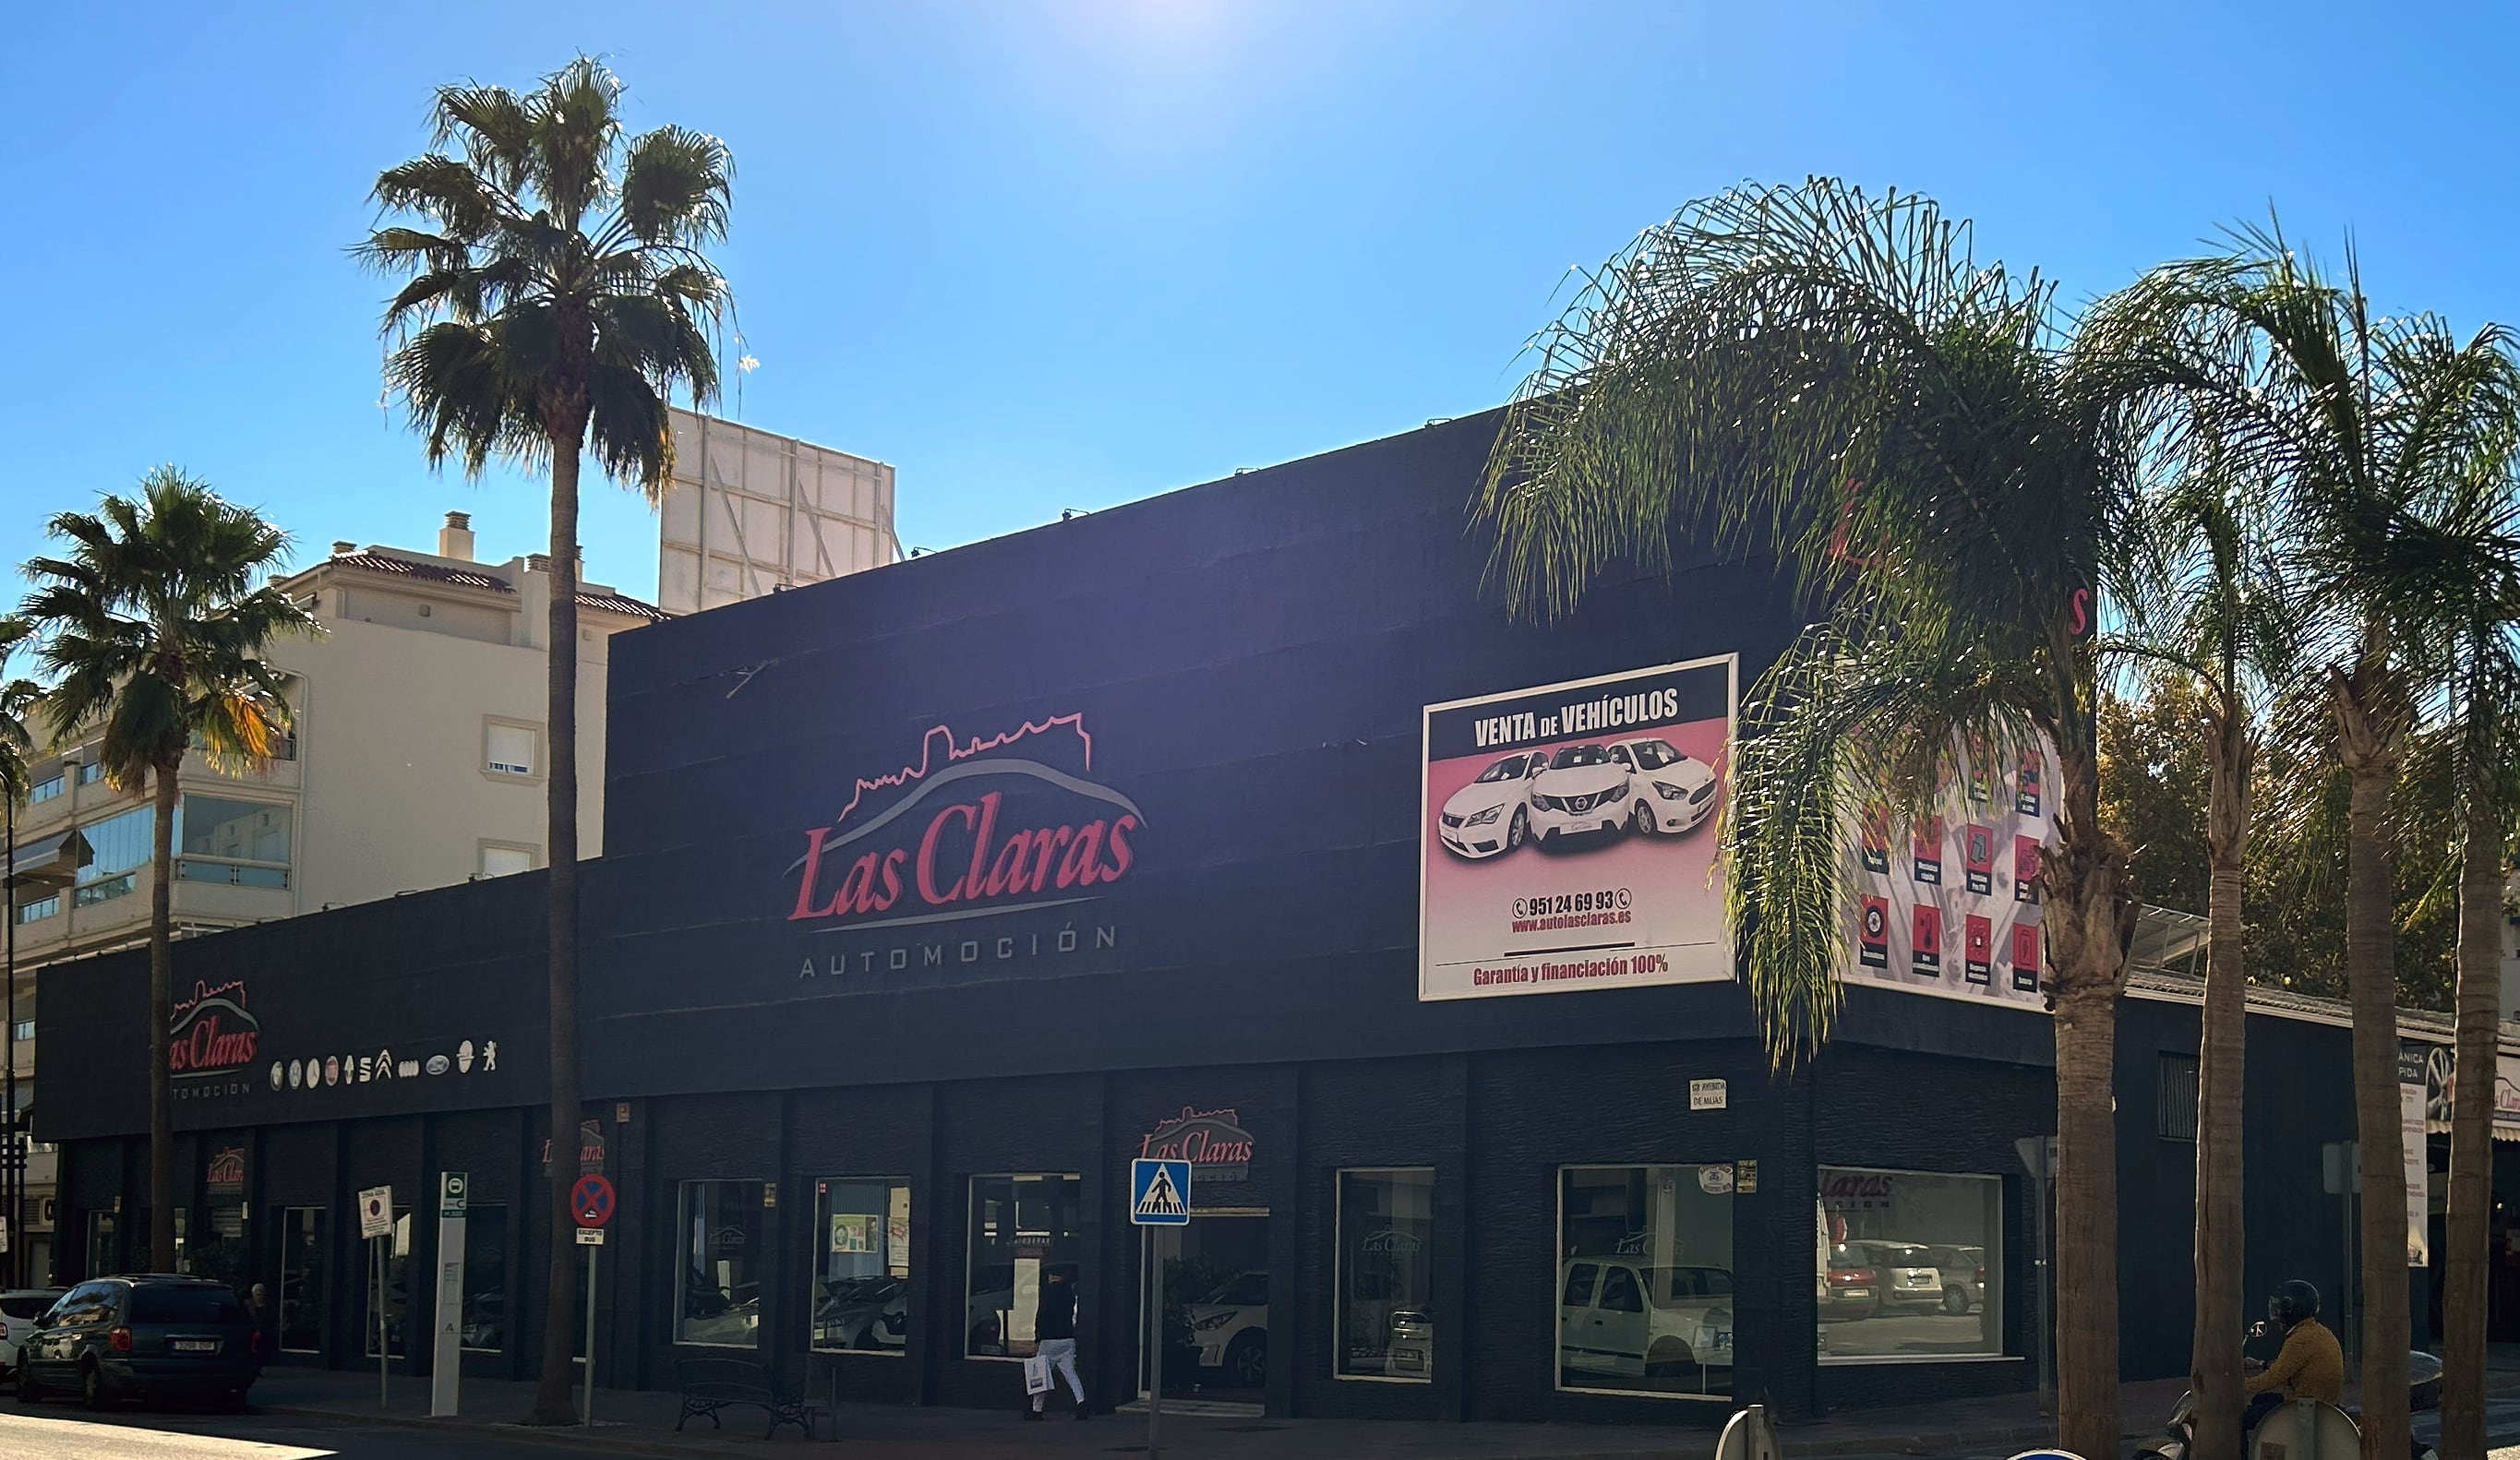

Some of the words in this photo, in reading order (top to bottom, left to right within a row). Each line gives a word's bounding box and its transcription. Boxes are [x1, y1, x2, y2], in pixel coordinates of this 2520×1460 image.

[1475, 712, 1536, 748] VENTA
[1541, 716, 1558, 737] DE
[1561, 688, 1678, 735] VEHÍCULOS
[787, 827, 908, 920] Las
[916, 791, 1138, 904] Claras
[1530, 896, 1553, 916] 951
[1555, 894, 1571, 914] 24
[1575, 892, 1592, 911] 69
[1596, 891, 1614, 909] 93
[1512, 910, 1631, 933] www.autolasclaras.es
[799, 922, 1115, 978] AUTOMOCIÓN
[1473, 963, 1529, 986] Garantía
[1531, 967, 1540, 983] y
[1541, 957, 1627, 981] financiación
[1630, 953, 1668, 974] 100%
[170, 1036, 188, 1071] as
[189, 1015, 258, 1069] Claras
[2398, 1048, 2424, 1064] ÁNICA
[2398, 1066, 2418, 1078] PIDA
[173, 1079, 250, 1100] TOMOCIÓN
[1141, 1133, 1178, 1159] Las
[1182, 1130, 1254, 1163] Claras
[1819, 1170, 1892, 1197] laras
